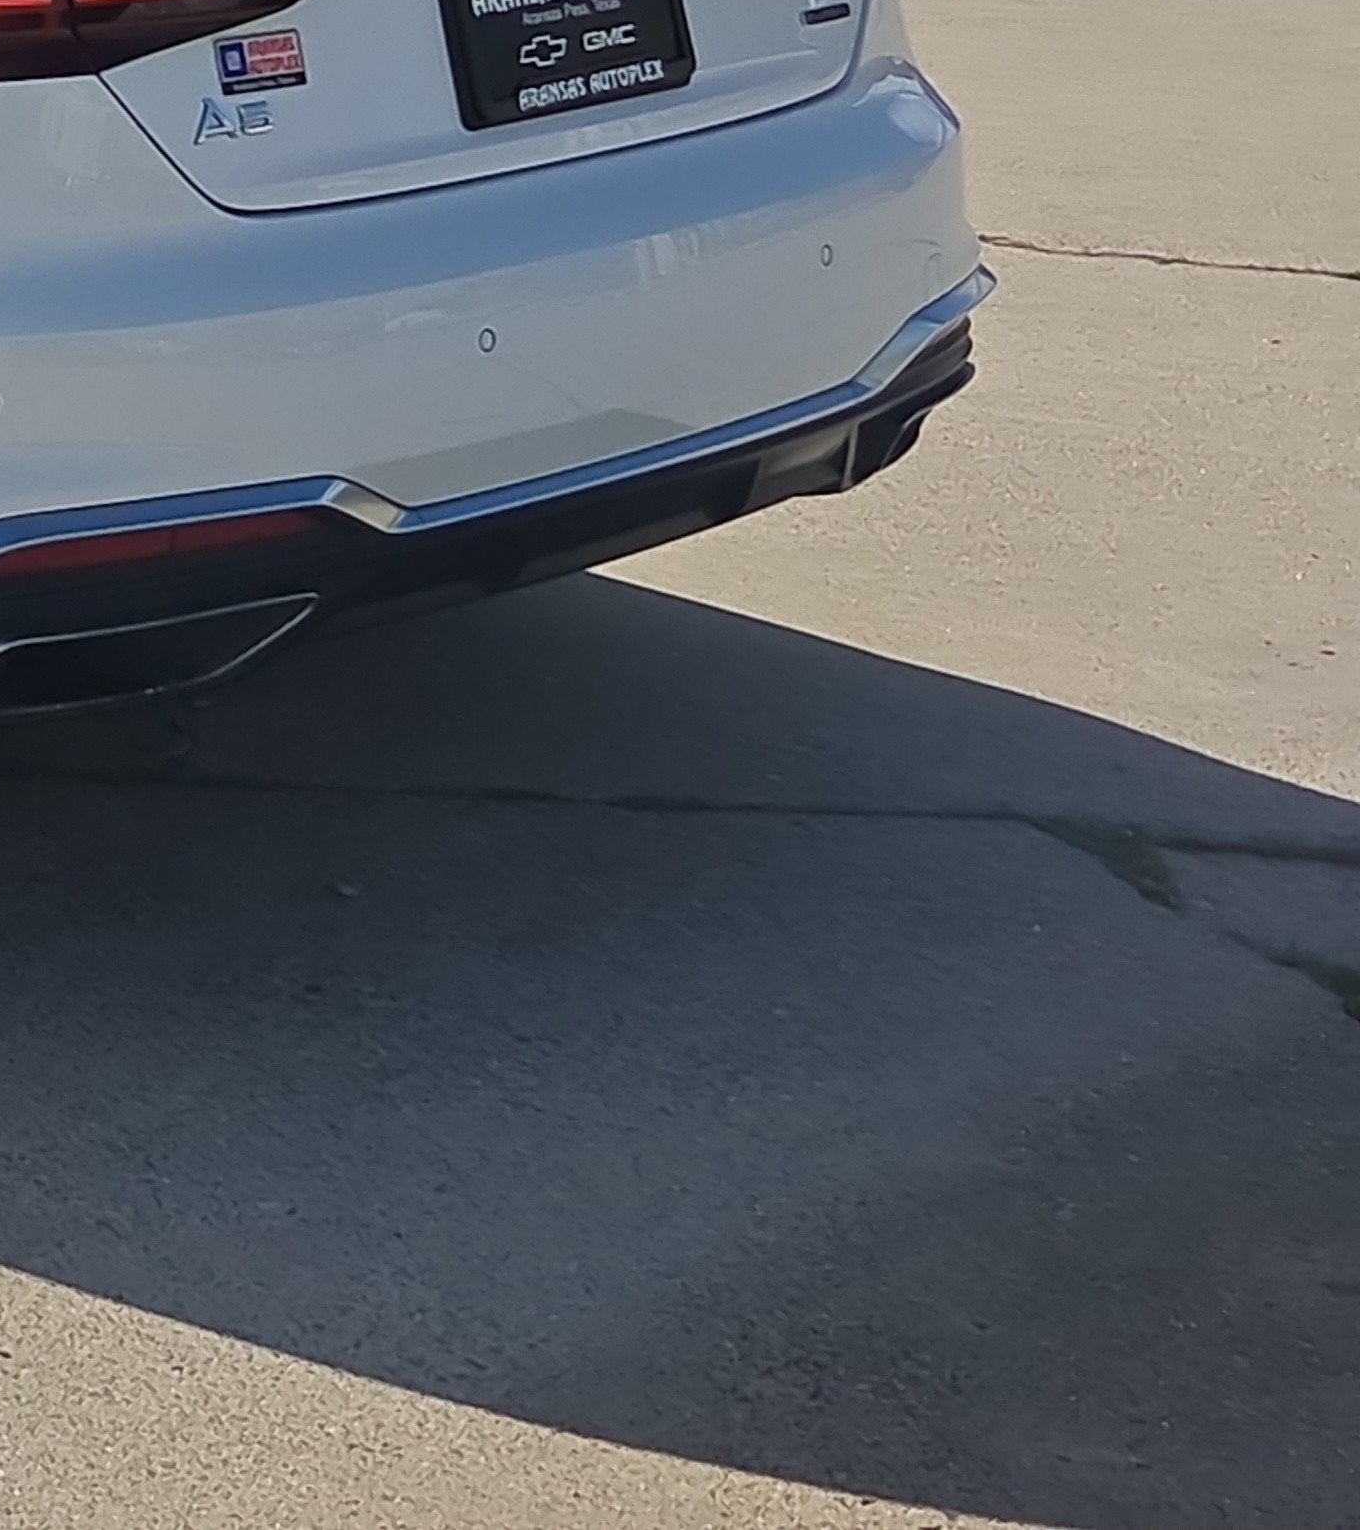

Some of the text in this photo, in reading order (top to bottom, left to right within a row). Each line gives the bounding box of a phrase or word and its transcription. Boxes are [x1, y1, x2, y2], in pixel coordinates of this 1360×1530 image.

[583, 24, 637, 52] GMC
[518, 60, 665, 112] ARANSAS AUTOPLEX
